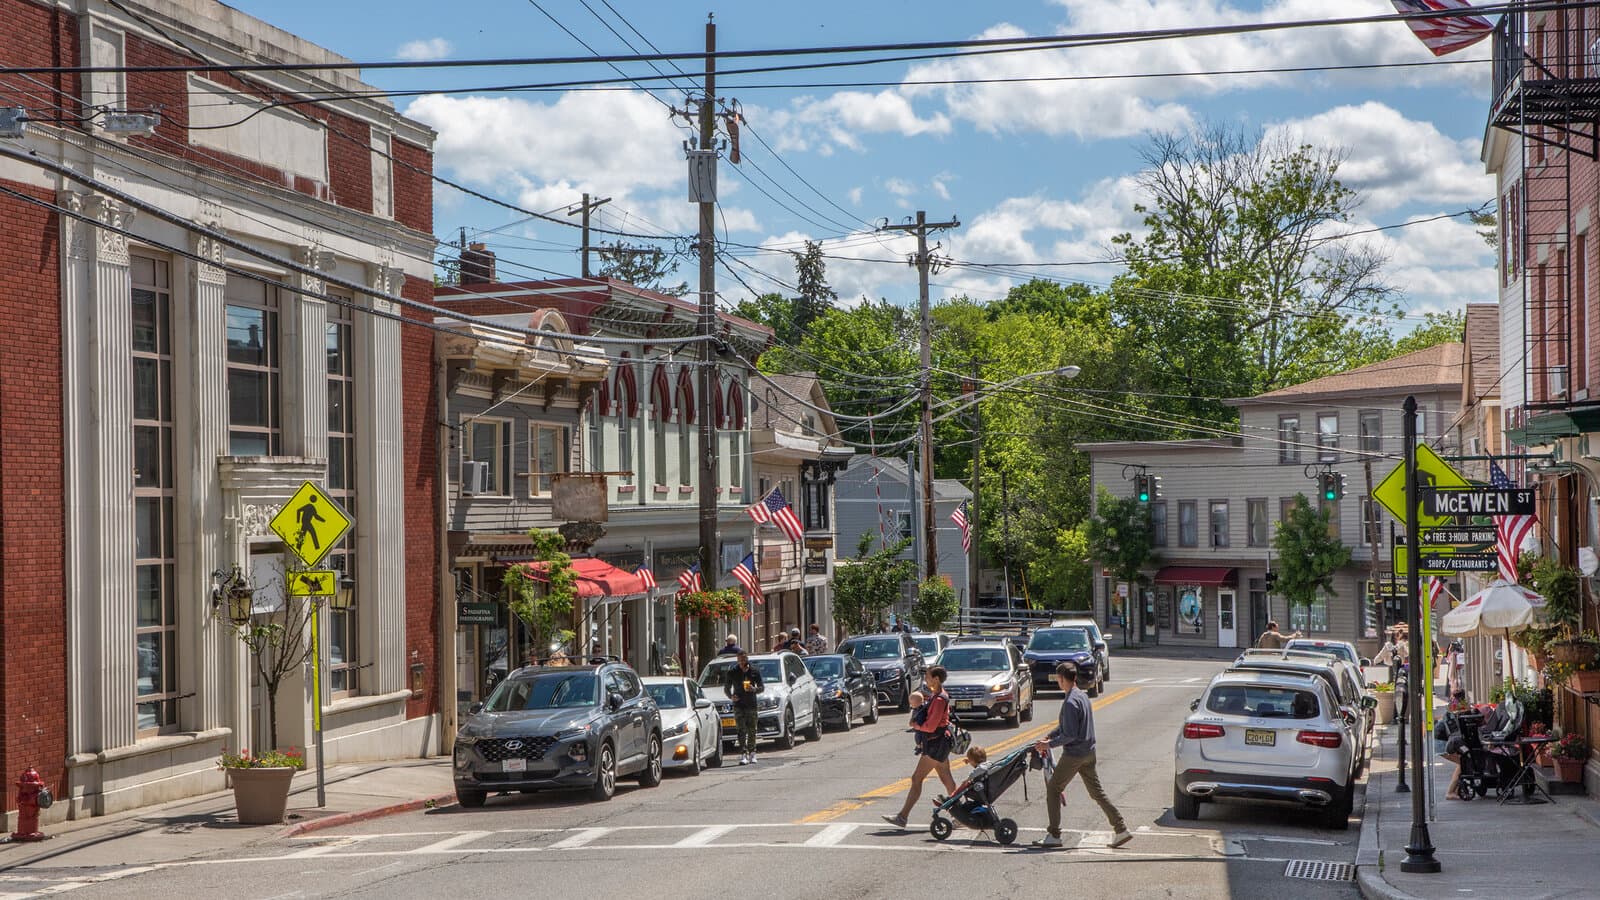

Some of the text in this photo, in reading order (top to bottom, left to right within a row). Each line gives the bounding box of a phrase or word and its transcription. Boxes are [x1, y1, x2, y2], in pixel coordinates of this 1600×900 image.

[1435, 492, 1531, 513] McEWEN ST
[1432, 532, 1495, 542] FREE 3-HOUR PARKING
